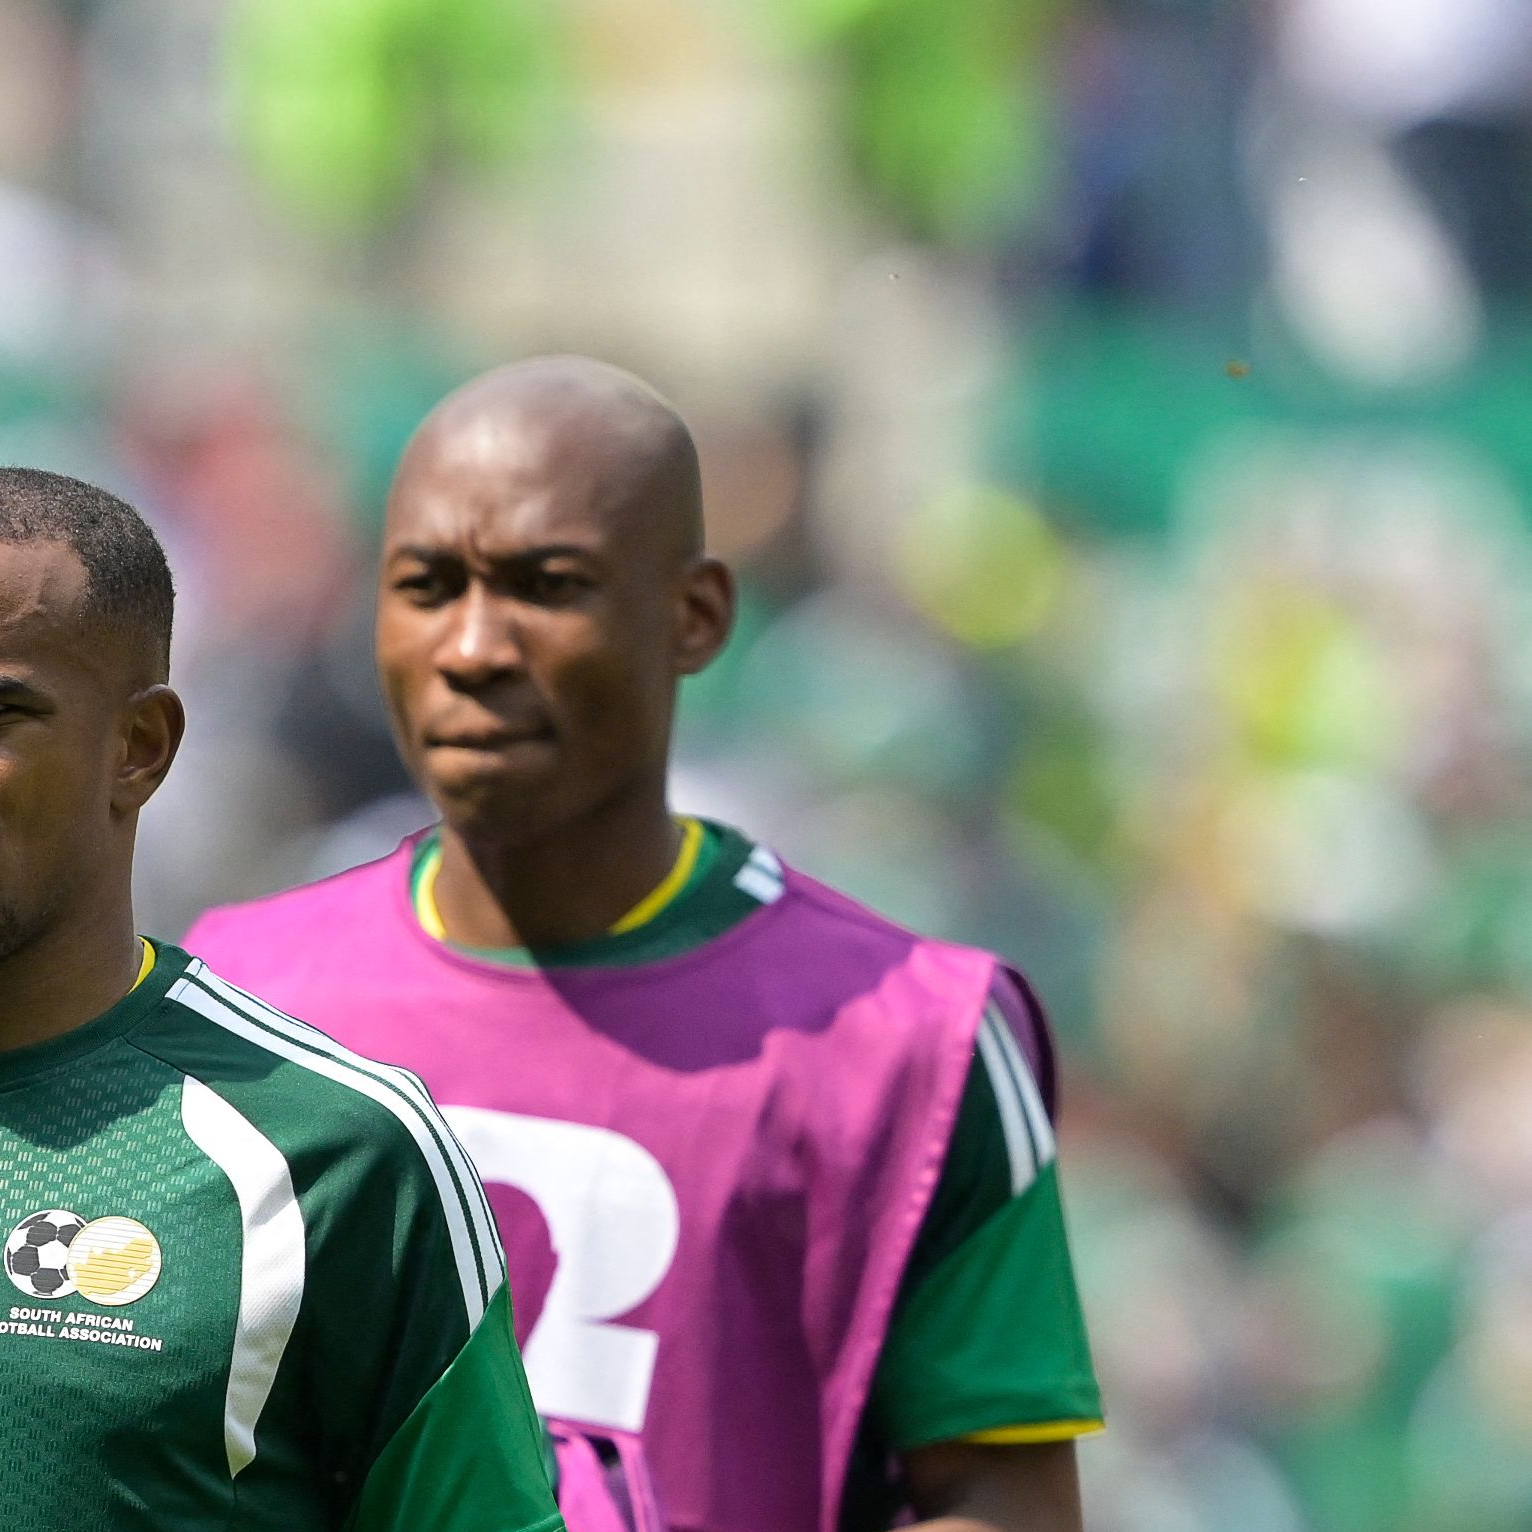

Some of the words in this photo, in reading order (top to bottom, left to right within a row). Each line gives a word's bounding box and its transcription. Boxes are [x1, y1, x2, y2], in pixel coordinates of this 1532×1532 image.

[9, 1307, 61, 1323] SOUTH
[65, 1312, 134, 1331] AFRICAN
[59, 1326, 163, 1351] ASSOCIATION
